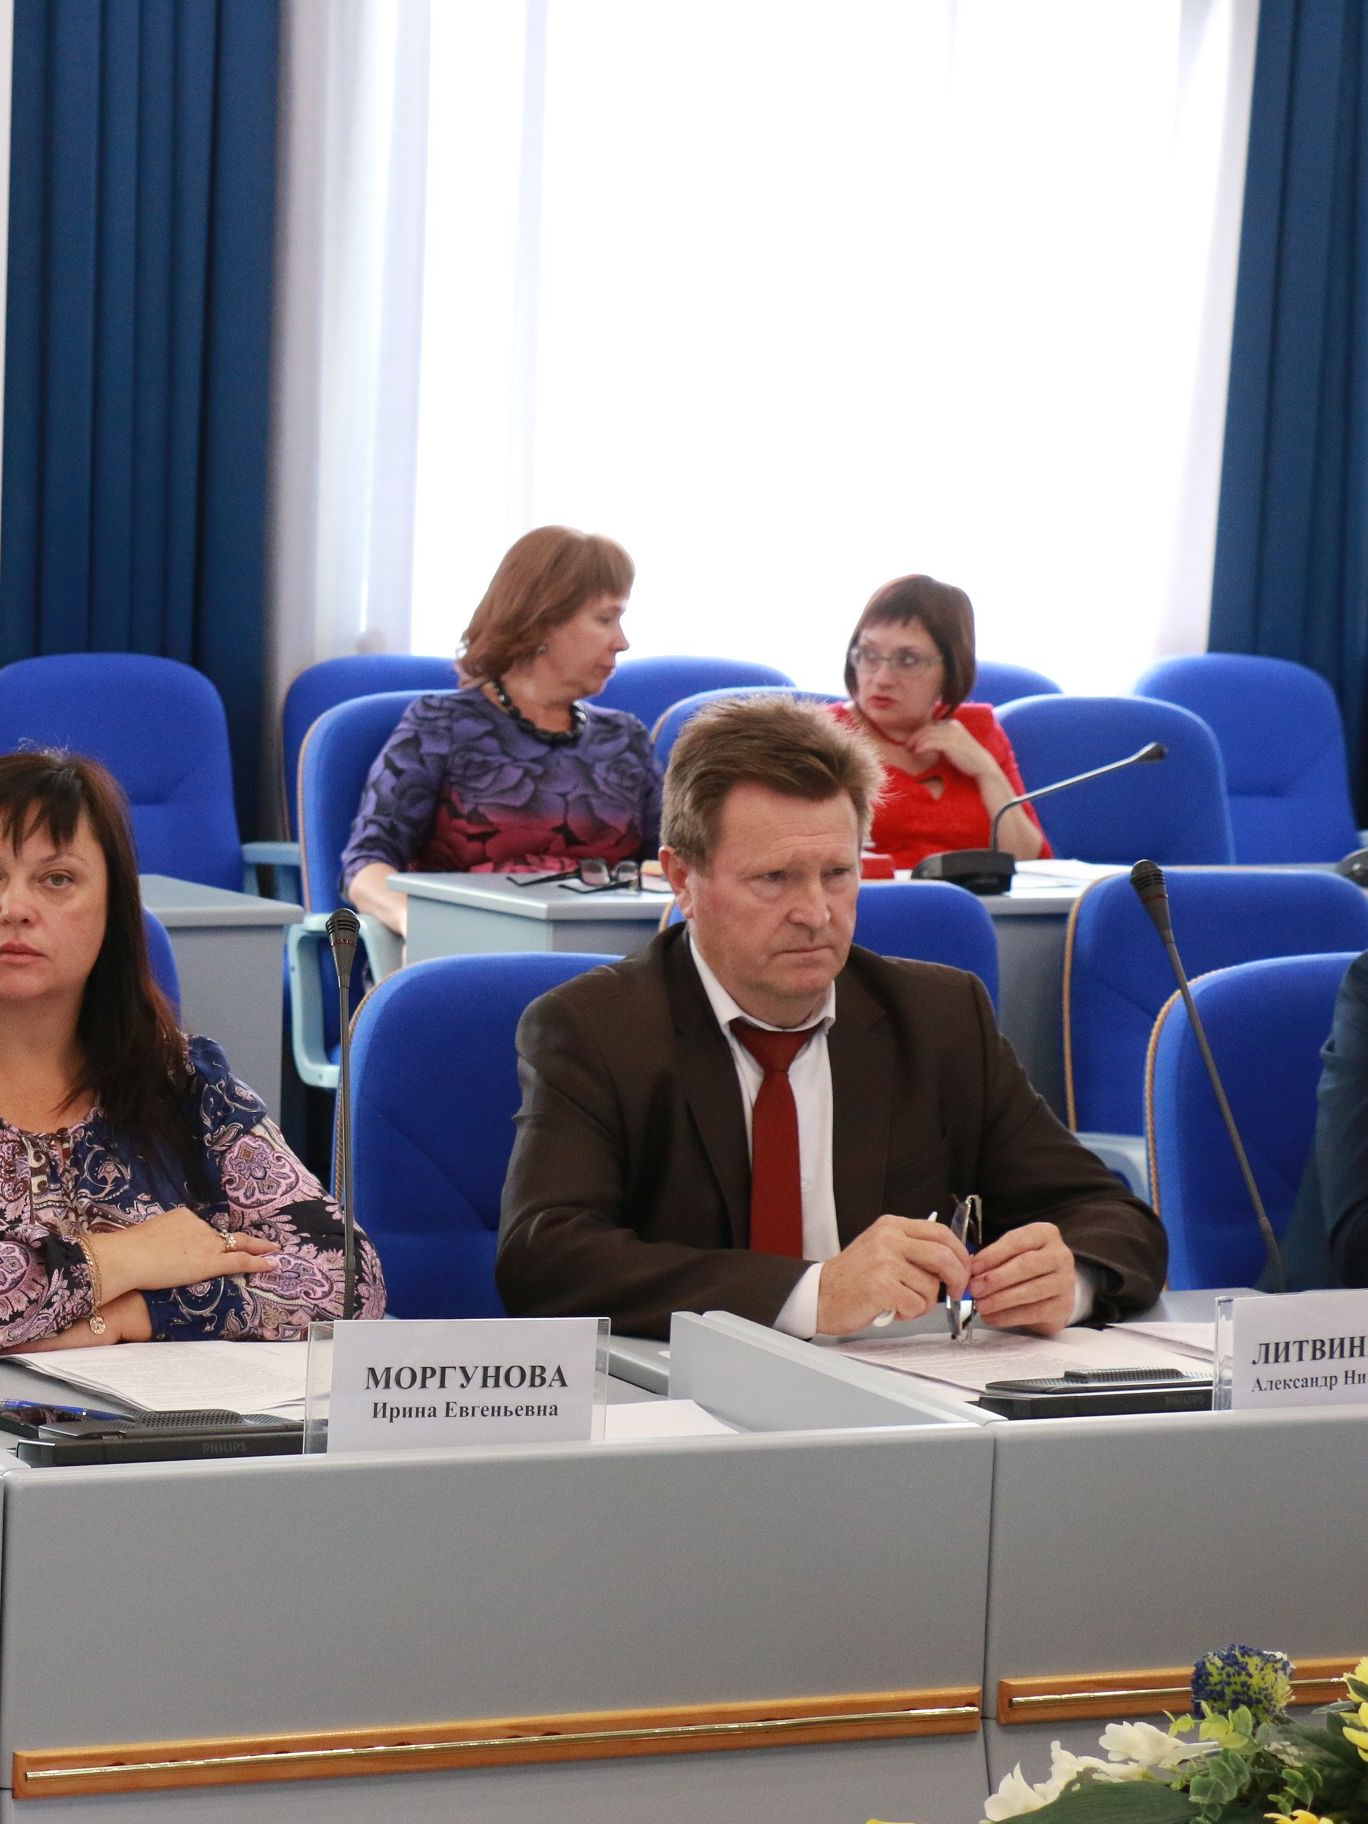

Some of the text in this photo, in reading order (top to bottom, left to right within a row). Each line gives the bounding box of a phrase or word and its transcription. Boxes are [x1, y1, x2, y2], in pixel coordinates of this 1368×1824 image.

[1251, 1335, 1368, 1366] ЛИТВИН
[364, 1364, 569, 1390] МОРГУНОВА
[1251, 1369, 1367, 1393] Александр Ни
[372, 1401, 559, 1424] Ирина Евгеньевна
[202, 1441, 248, 1455] PHILIPS
